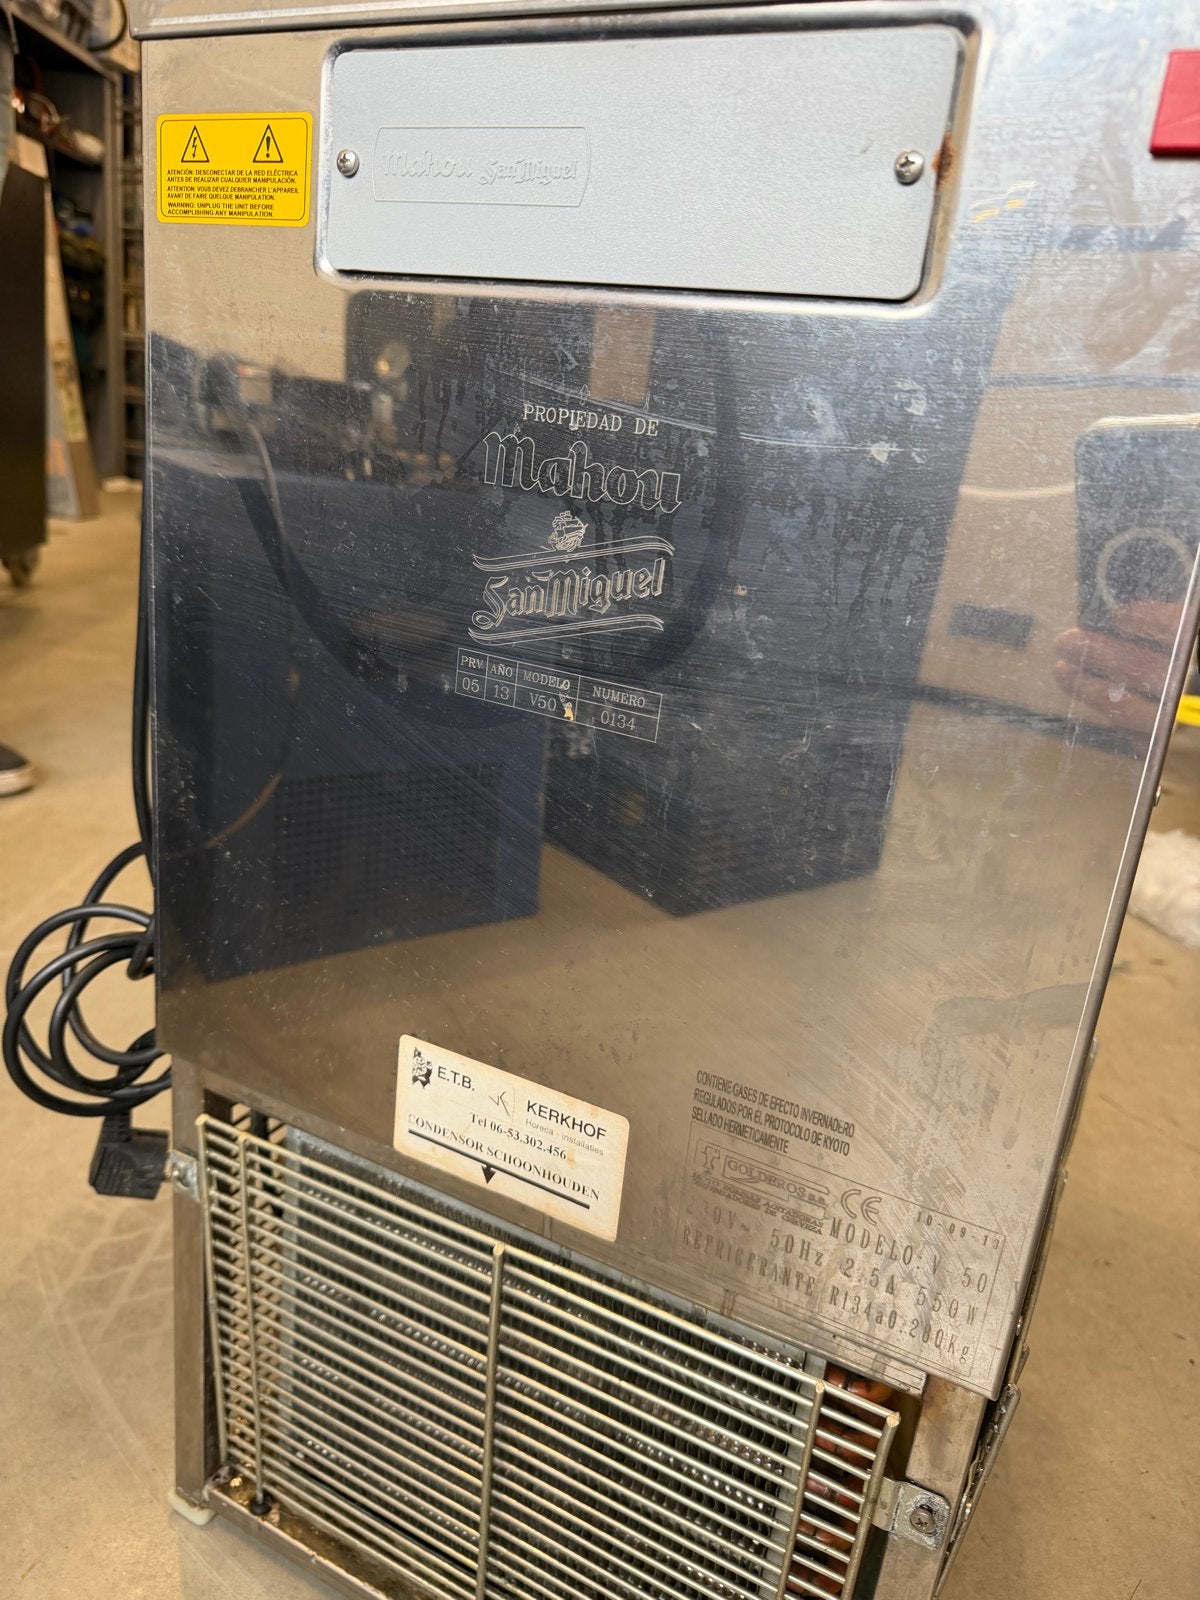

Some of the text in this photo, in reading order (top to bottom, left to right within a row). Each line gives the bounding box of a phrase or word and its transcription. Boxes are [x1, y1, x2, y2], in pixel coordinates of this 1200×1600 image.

[267, 169, 299, 177] ELÉCTRICA
[381, 150, 475, 179] Mahou
[523, 403, 660, 437] PROPIEDAD DE
[482, 430, 683, 514] Mahou
[460, 655, 647, 709] PRV AÑO MODELO NUMERO
[461, 676, 637, 731] 05 13 V50 0134
[436, 1066, 476, 1092] E.T.B.
[525, 1118, 554, 1136] Horeca
[526, 1099, 608, 1140] KERKHOF
[693, 1088, 737, 1115] REGULADOS
[737, 1103, 753, 1122] POR
[764, 1114, 811, 1142] PROTOCOLO
[810, 1130, 822, 1147] DE
[822, 1133, 850, 1156] KYOTO
[696, 1070, 855, 1138] CONTIENE GASES DE EFECTO INVERNADERO
[469, 1111, 567, 1160] Tel 06-53.302.456
[691, 1106, 789, 1154] SELLADO HERMETICAMENTE
[408, 1113, 601, 1201] CONDENSOR SCHOONHOUDEN
[727, 1159, 807, 1198] GOLDEROS
[682, 1224, 816, 1297] REFRIGERANTE
[769, 1228, 824, 1267] 50Hz
